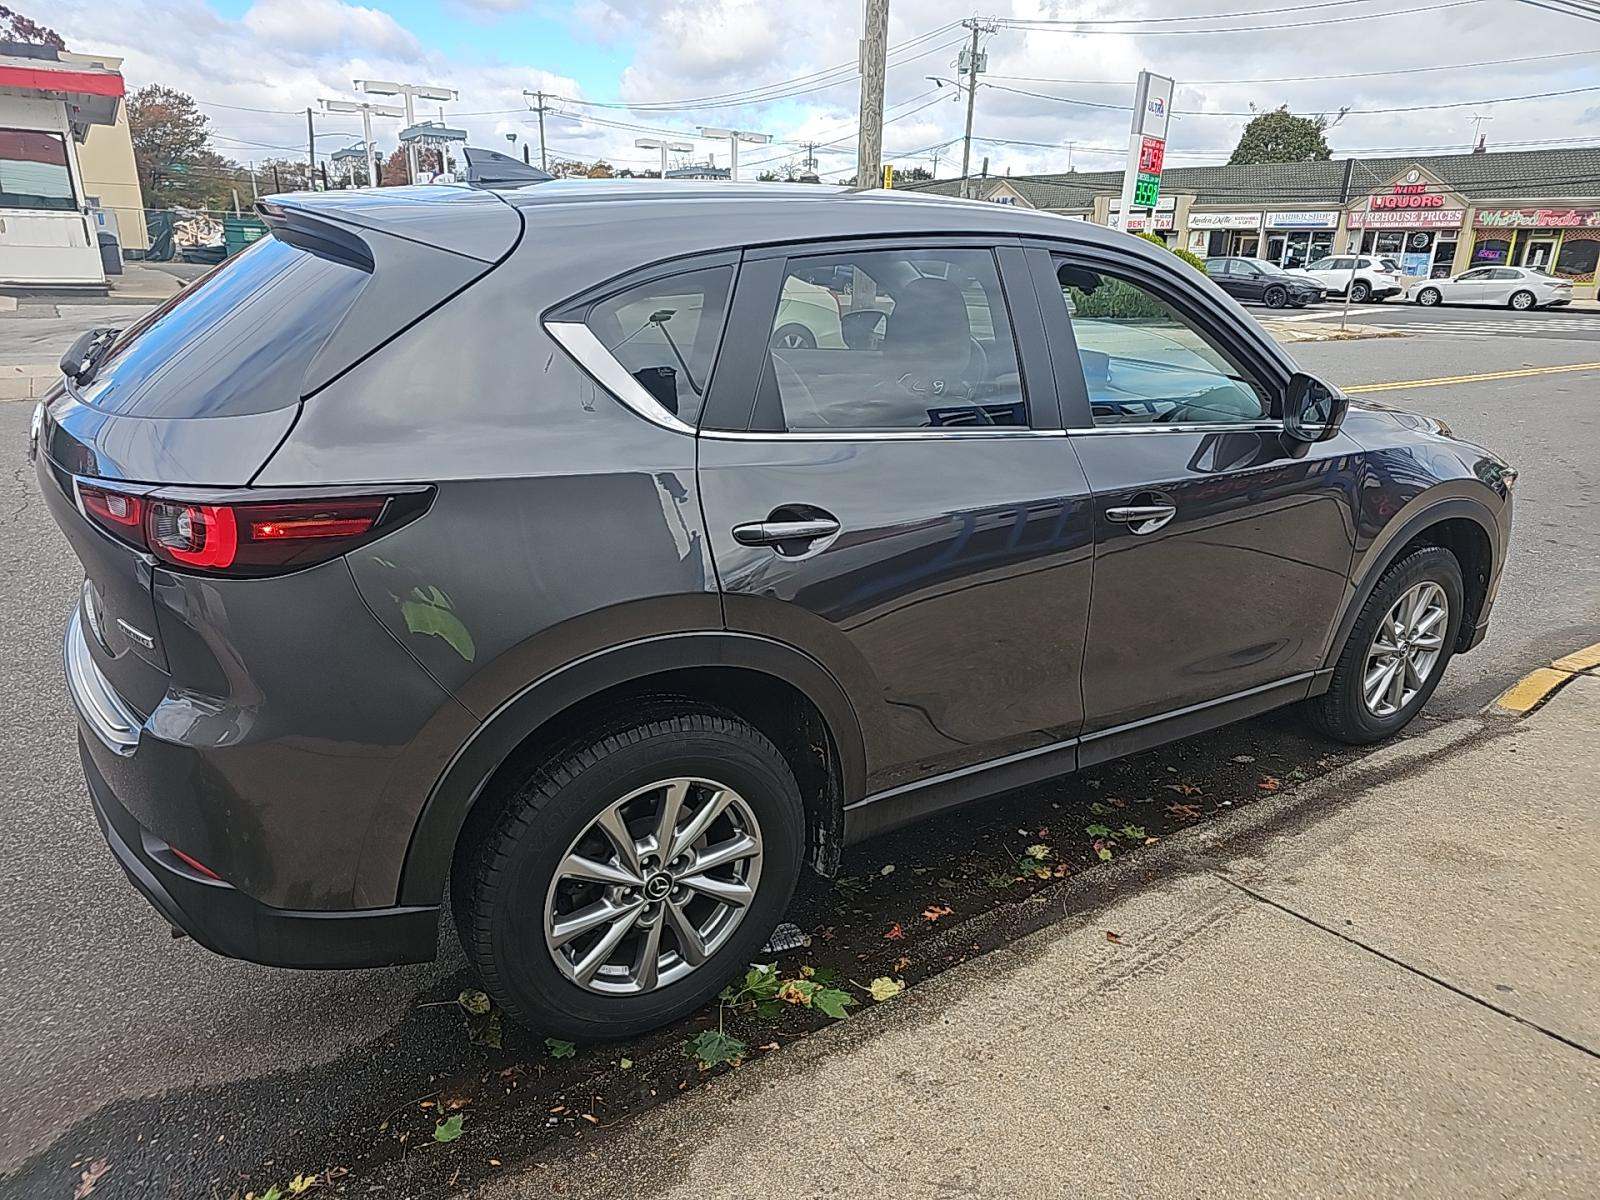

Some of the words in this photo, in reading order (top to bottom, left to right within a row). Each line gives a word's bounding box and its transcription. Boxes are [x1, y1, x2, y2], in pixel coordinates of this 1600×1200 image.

[1148, 101, 1164, 115] ULTRA
[1372, 195, 1444, 209] LIQUORS
[1274, 213, 1307, 221] BARBER
[1308, 212, 1331, 220] SHOP
[1351, 211, 1418, 222] WAREHOUSE
[1420, 210, 1462, 222] PRICES
[1154, 219, 1171, 228] TAX
